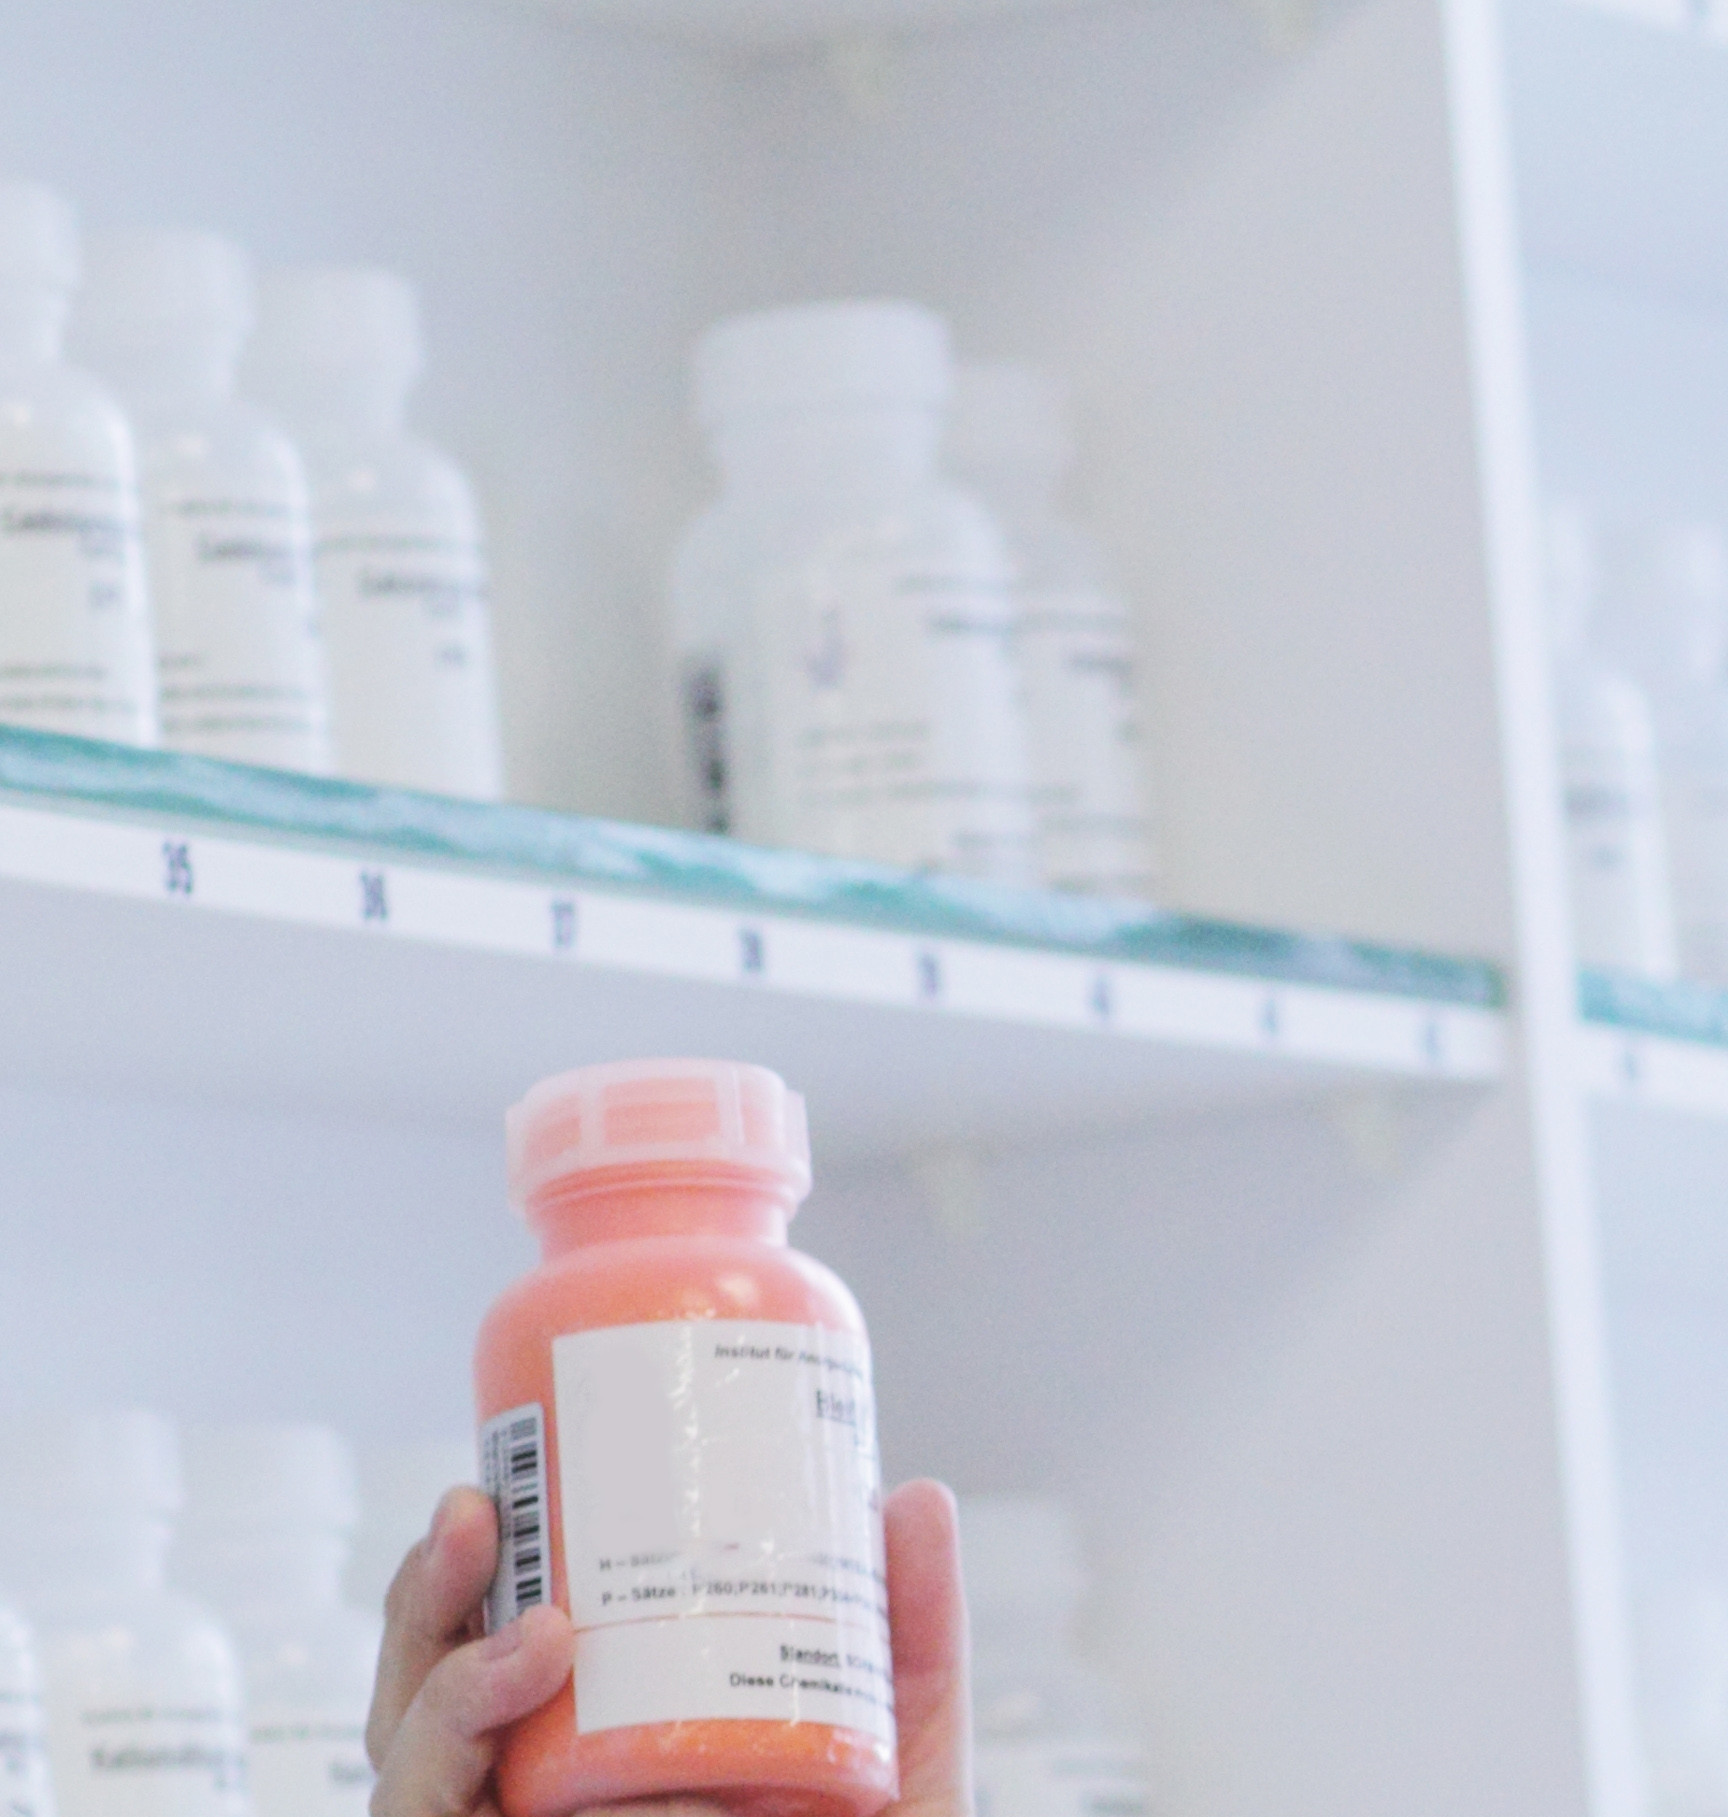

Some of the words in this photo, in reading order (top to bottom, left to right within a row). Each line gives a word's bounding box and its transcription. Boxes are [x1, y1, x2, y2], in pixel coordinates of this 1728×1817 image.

[162, 840, 193, 895] 35
[714, 1344, 770, 1360] Institut
[775, 1347, 795, 1361] für
[602, 1591, 613, 1606] P
[729, 1672, 774, 1688] Diese
